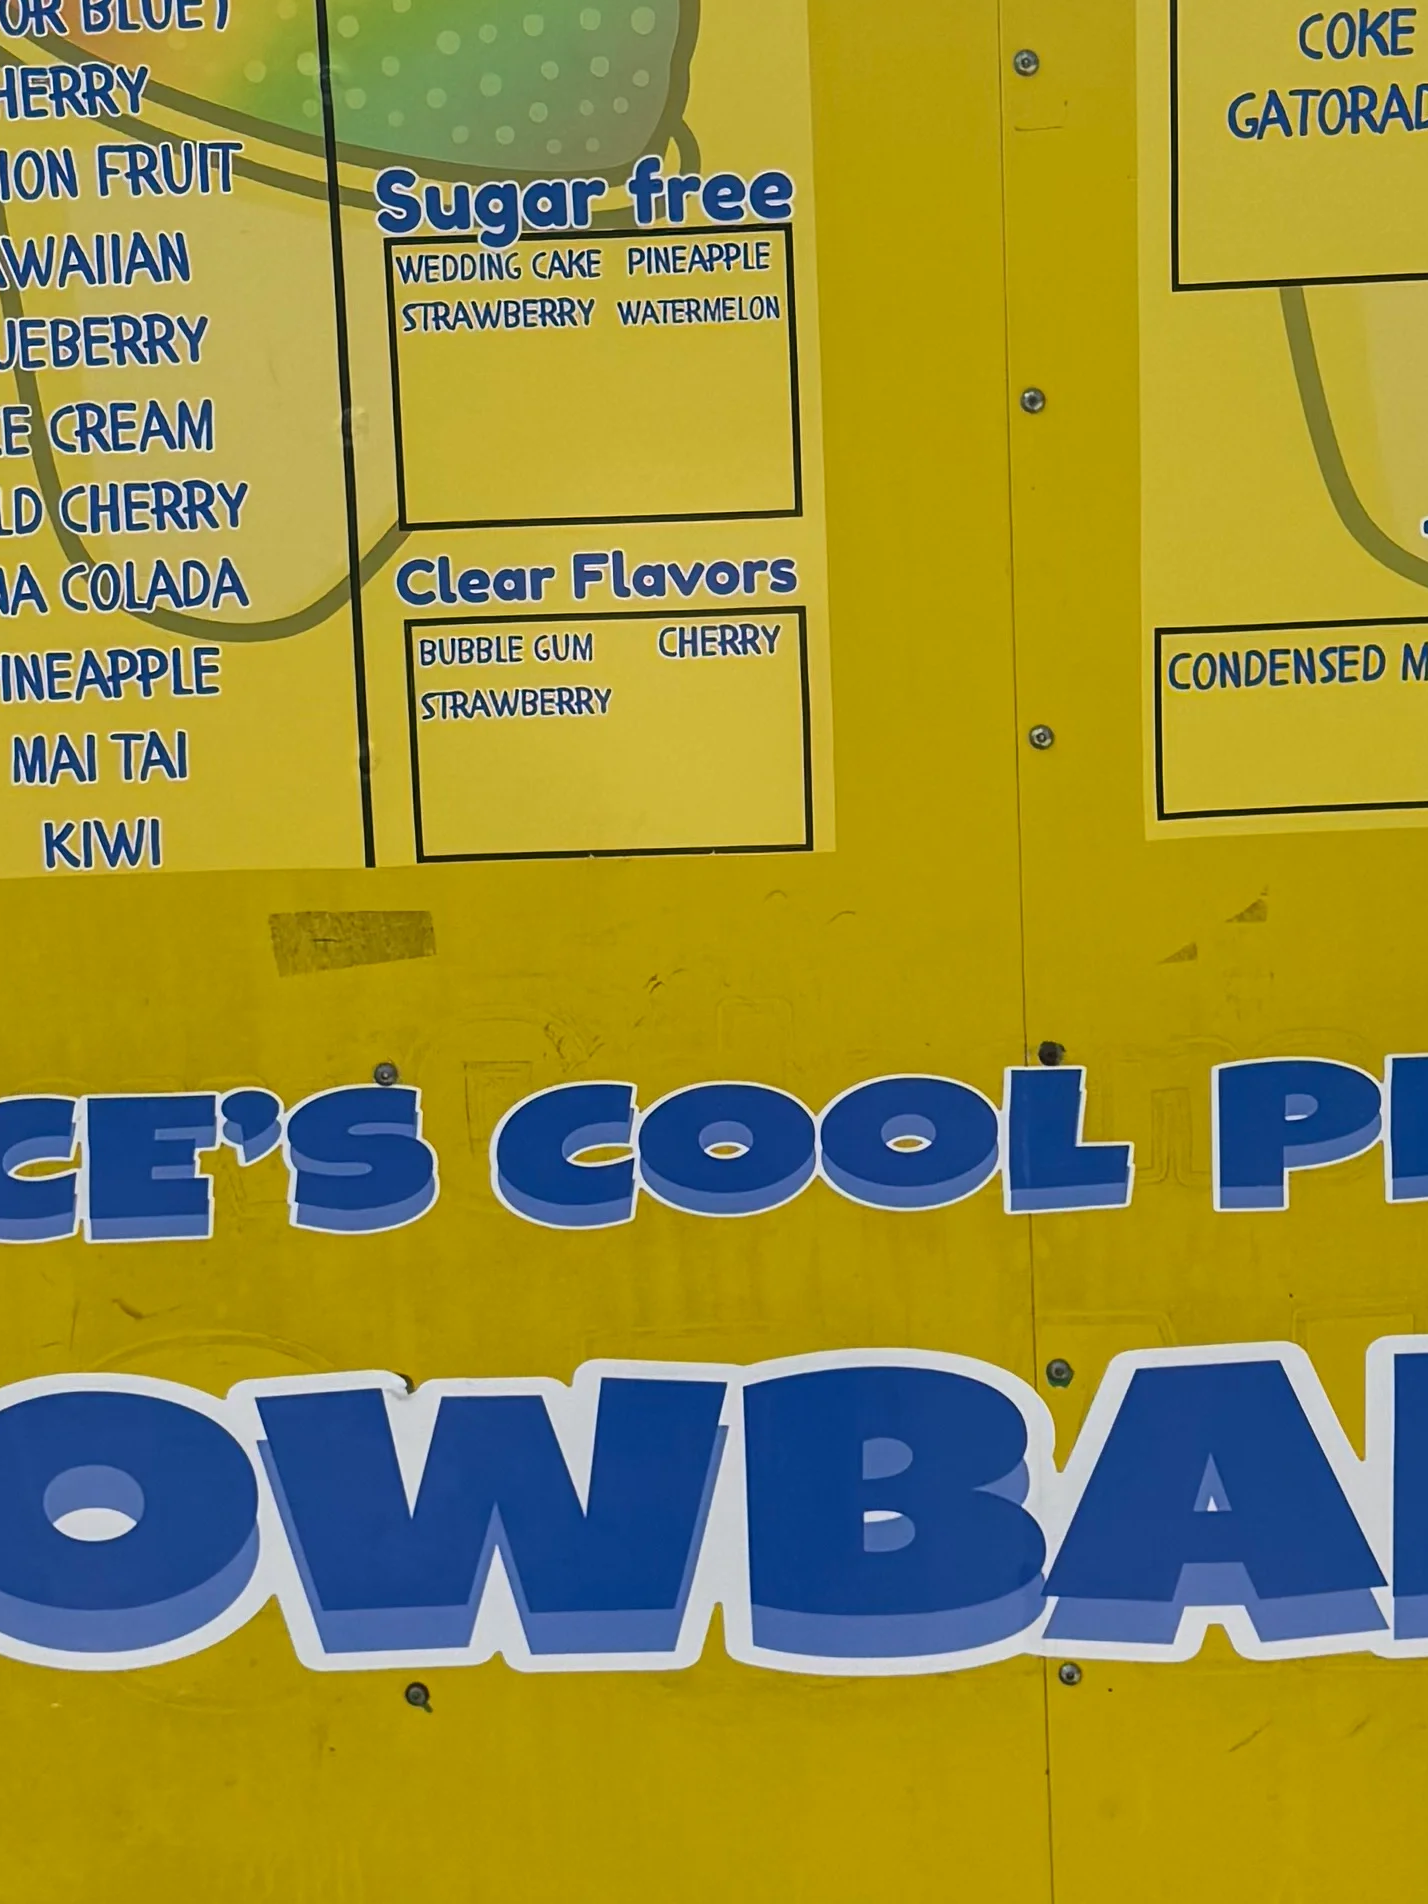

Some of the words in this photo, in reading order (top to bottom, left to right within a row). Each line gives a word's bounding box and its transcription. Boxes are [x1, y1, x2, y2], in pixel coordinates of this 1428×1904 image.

[1300, 9, 1414, 59] COKE
[98, 143, 241, 196] FRUIT
[377, 170, 605, 247] Sugar
[629, 157, 792, 223] free
[396, 253, 520, 283] WEDDING
[533, 250, 599, 279] CAKE
[628, 243, 768, 273] PINEAPPLE
[403, 298, 593, 331] STRAWBERRY
[618, 297, 779, 324] WATERMELON
[51, 400, 212, 452] CREAM
[58, 480, 247, 533] CHERRY
[62, 558, 249, 611] COLADA
[397, 556, 554, 605] Clear
[573, 551, 796, 599] Flavors
[420, 637, 522, 666] BUBBLE
[535, 635, 591, 660] GUM
[659, 625, 777, 657] CHERRY
[1169, 646, 1384, 689] CONDENSED
[421, 688, 608, 719] STRAWBERRY
[14, 735, 96, 784] MAI
[110, 731, 186, 780] TAI
[45, 820, 160, 868] KIWI
[493, 1068, 1131, 1227] COOL
